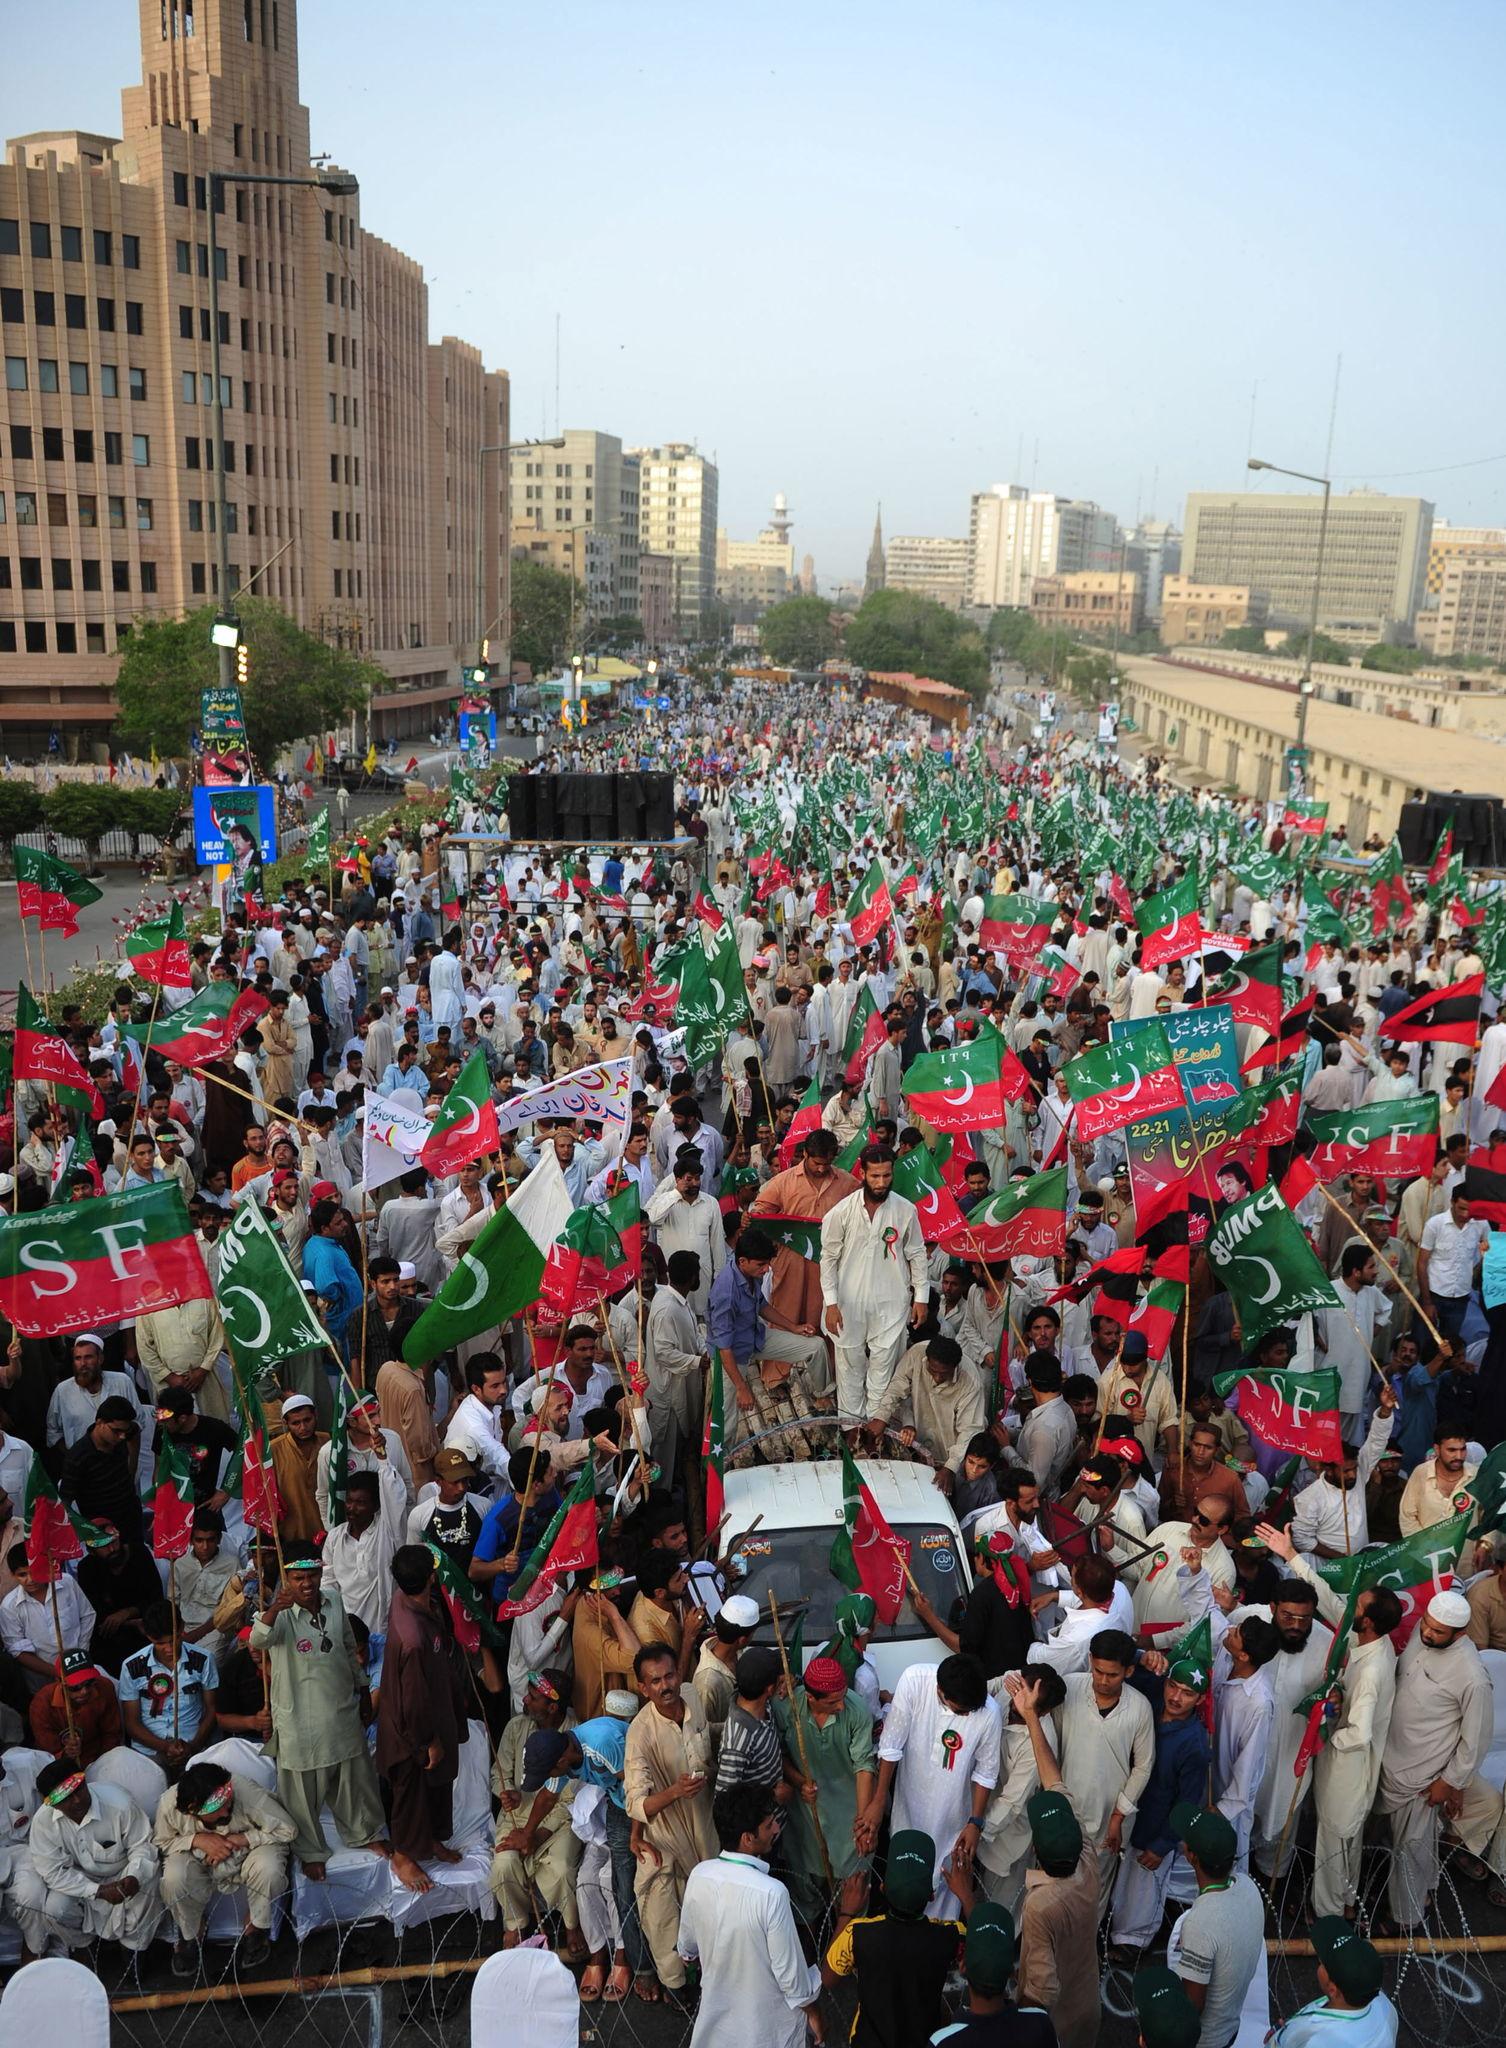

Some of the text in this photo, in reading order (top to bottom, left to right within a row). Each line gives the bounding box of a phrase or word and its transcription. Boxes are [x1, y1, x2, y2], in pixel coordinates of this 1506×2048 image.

[202, 841, 224, 850] HEAV
[205, 851, 224, 860] NOT
[1201, 938, 1243, 950] MOVEMENT
[1212, 933, 1234, 942] AAFIA
[1192, 1014, 1211, 1038] چلو
[1213, 1012, 1232, 1033] چلو
[28, 1060, 65, 1075] انصاف
[1131, 1119, 1171, 1138] 22-21
[3, 1209, 78, 1229] Knowledge
[988, 1220, 1032, 1254] تحریک
[1030, 1222, 1065, 1249] پاکستان
[123, 1287, 180, 1313] انصاف
[1297, 1442, 1323, 1458] انصاف
[154, 1525, 188, 1550] نصاف
[540, 1552, 585, 1576] انصاف
[1363, 1541, 1411, 1571] Knowledge
[64, 1651, 87, 1666] PTI
